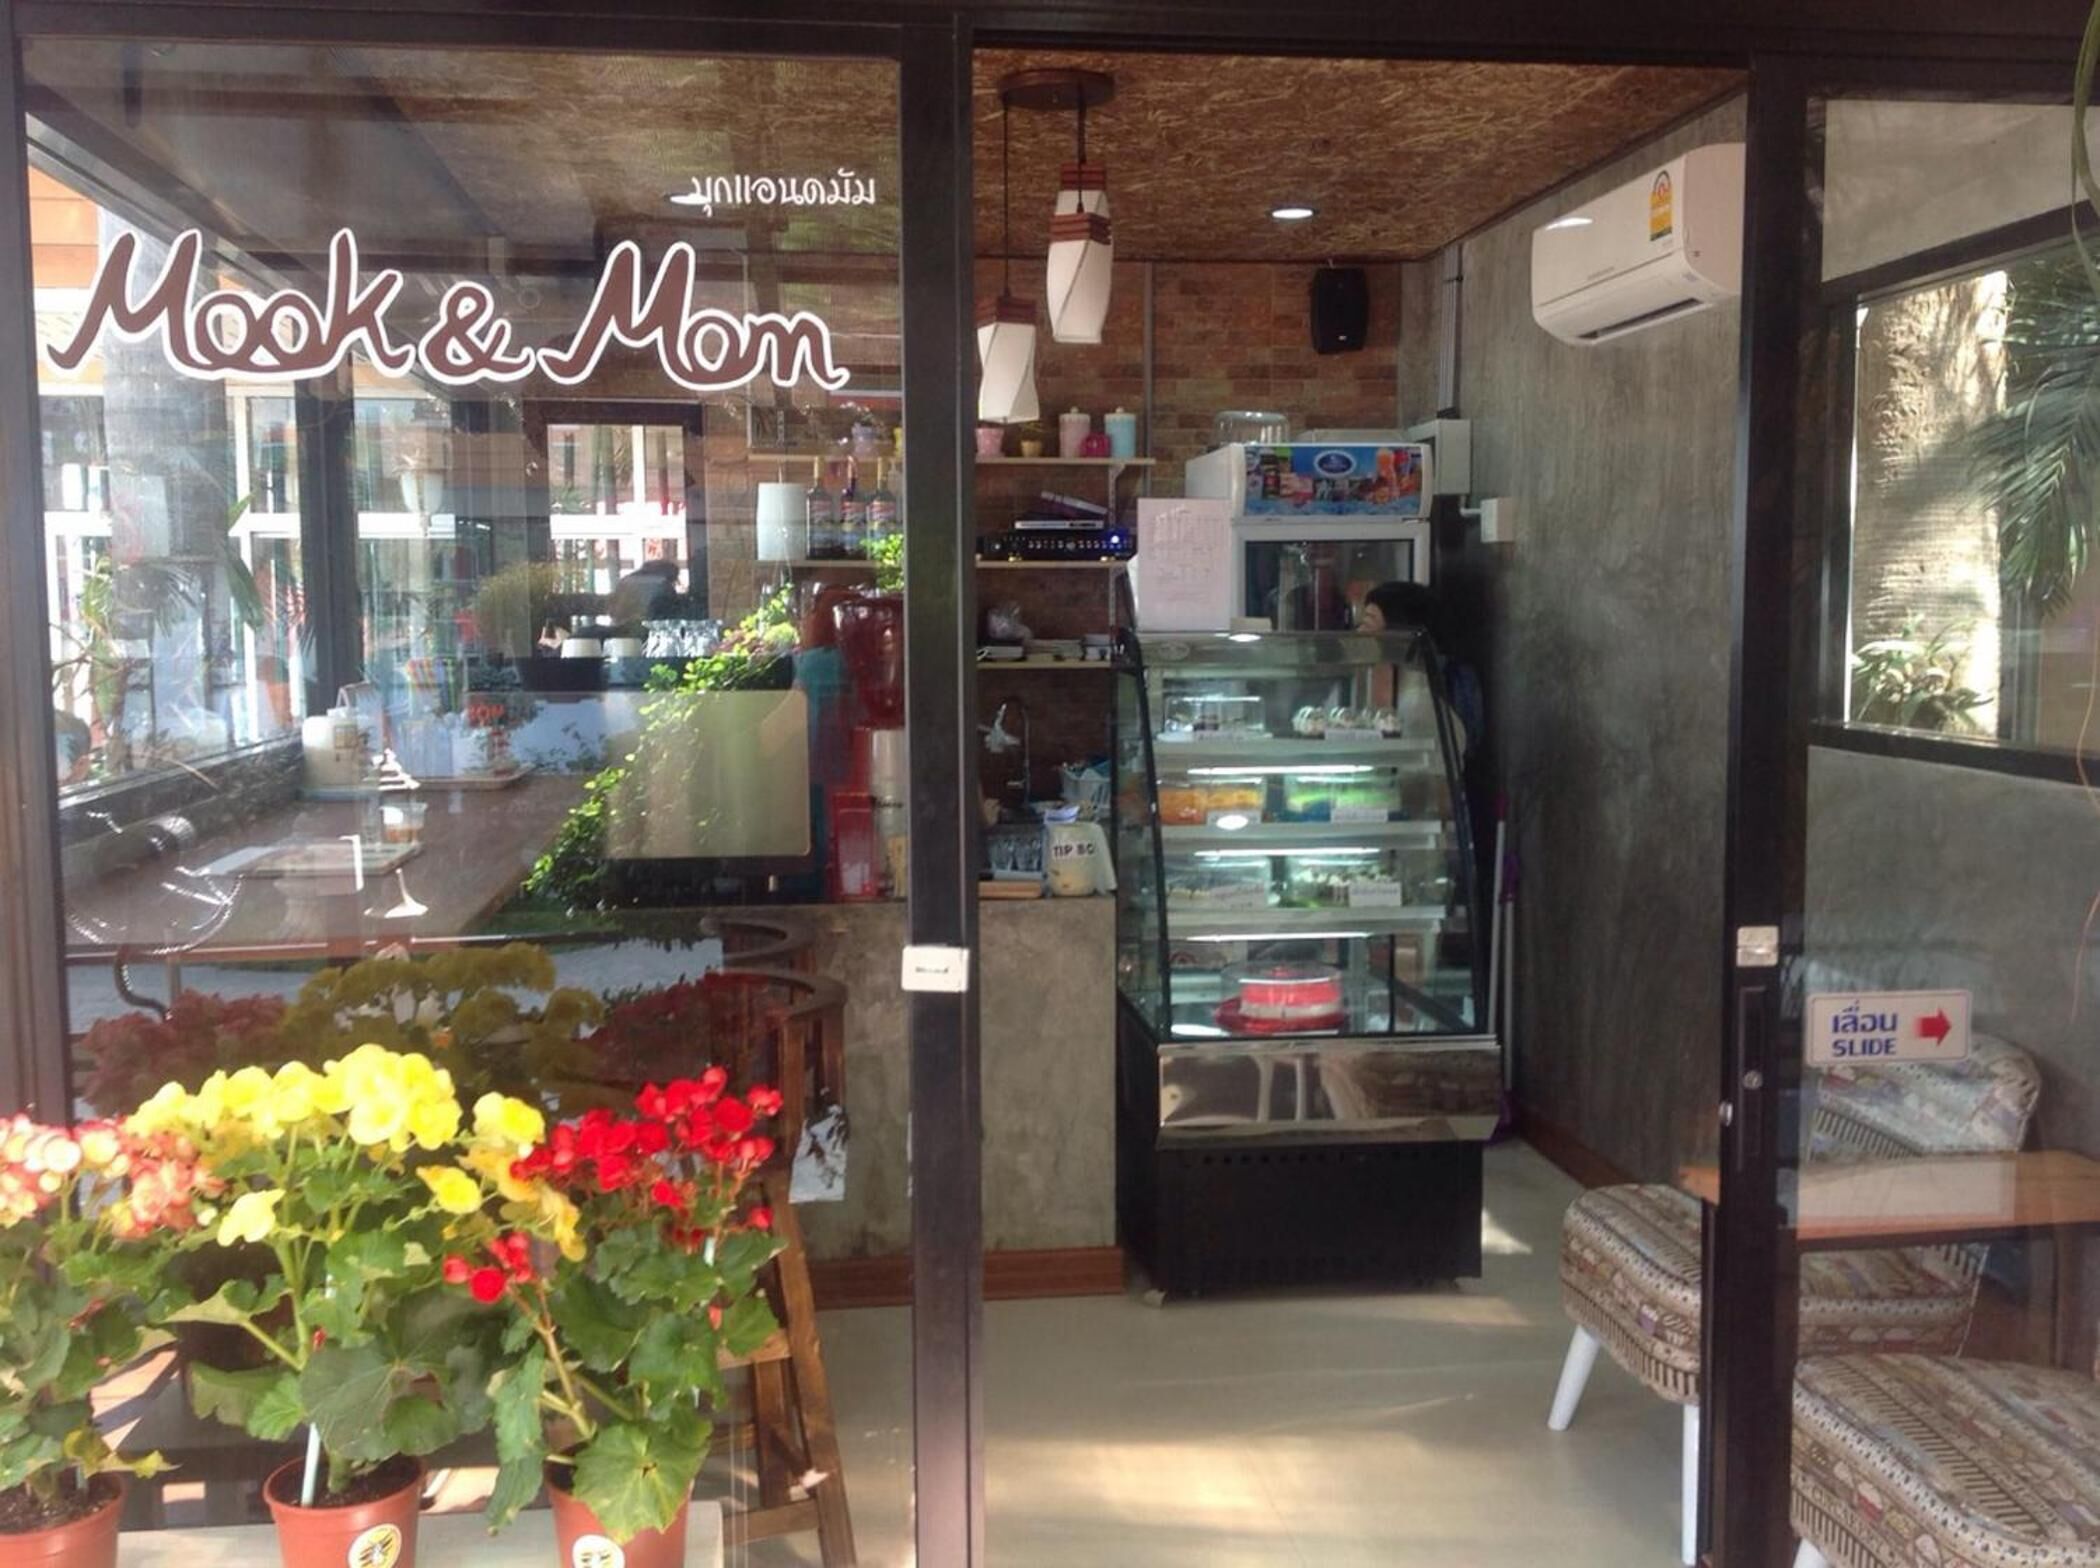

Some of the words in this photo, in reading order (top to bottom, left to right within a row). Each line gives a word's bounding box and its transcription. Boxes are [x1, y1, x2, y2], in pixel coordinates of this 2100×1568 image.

[46, 227, 417, 381] Mook
[418, 280, 537, 386] &
[1053, 844, 1073, 857] TIP
[1831, 1000, 1899, 1034] เลื่อน
[1831, 1037, 1898, 1058] SLIDE
